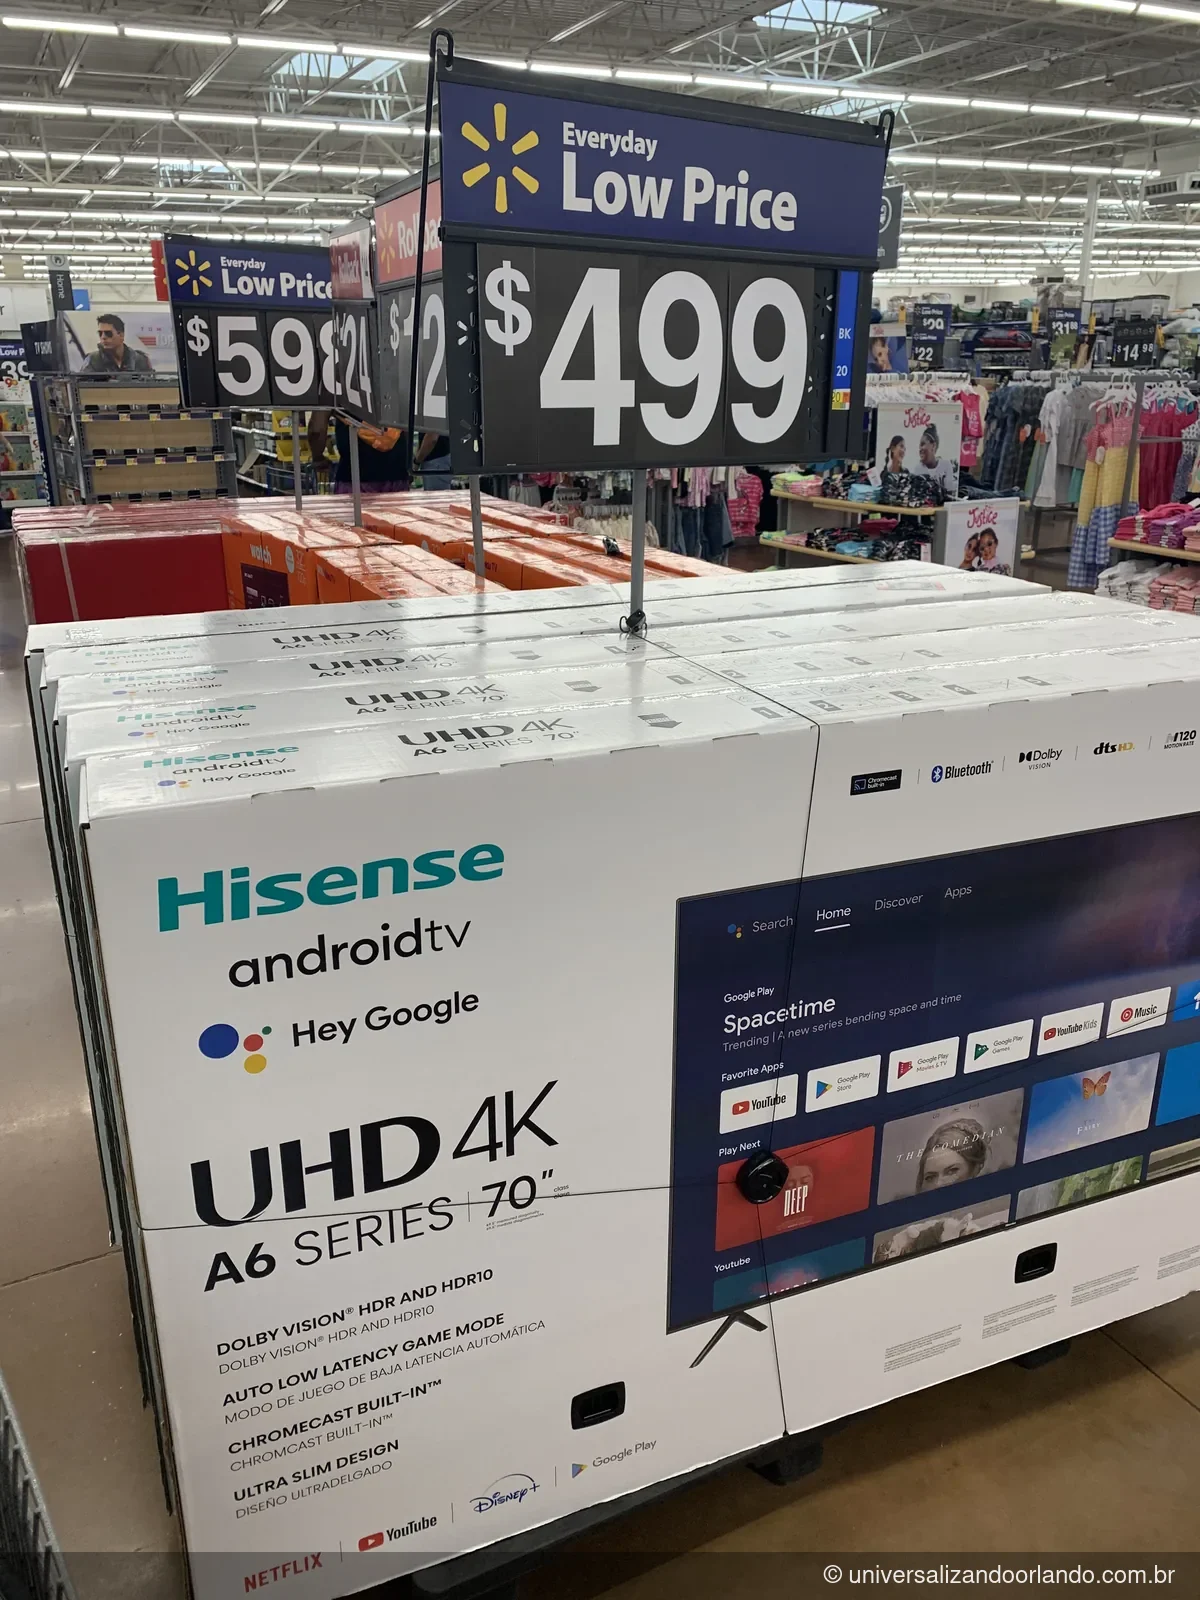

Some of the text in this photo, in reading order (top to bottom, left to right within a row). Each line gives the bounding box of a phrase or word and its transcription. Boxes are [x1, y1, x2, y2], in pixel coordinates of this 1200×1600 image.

[562, 121, 658, 162] Everyday
[563, 151, 797, 231] Low Price
[220, 256, 265, 272] Everyday
[57, 274, 65, 299] Home
[221, 268, 332, 299] Low Price
[838, 328, 852, 340] BK
[484, 260, 807, 446] $499
[836, 365, 848, 377] 20
[904, 408, 931, 428] Justice
[967, 506, 998, 529] Justice
[250, 544, 272, 566] watch
[272, 632, 361, 645] UHD
[309, 657, 405, 670] UHD
[103, 669, 228, 683] Hisense
[345, 689, 450, 706] UHD
[356, 707, 387, 715] A6
[393, 698, 465, 711] SERIES
[117, 704, 256, 723] Hisense
[141, 713, 244, 728] androidtv
[166, 722, 250, 735] Hey Google
[398, 718, 575, 746] UHD 4K
[413, 747, 447, 757] A6
[453, 737, 533, 752] SERIES
[1033, 747, 1062, 763] Dolby
[1093, 742, 1117, 755] dts
[143, 746, 299, 769] Hisense
[173, 758, 286, 775] androidtv
[1028, 761, 1051, 771] VISION
[202, 769, 296, 783] Hey Google
[867, 774, 898, 785] Chromecast
[867, 781, 885, 789] built-in
[157, 843, 504, 933] Hisense
[944, 884, 973, 900] Apps
[874, 893, 923, 911] Discover
[816, 905, 851, 921] Home
[752, 915, 794, 933] Search
[229, 917, 471, 988] androidtv
[723, 985, 775, 1004] Google Play
[291, 990, 479, 1047] Hey Google
[723, 996, 836, 1037] Spacetime
[1134, 1004, 1157, 1018] Music
[723, 1033, 770, 1053] Trending
[788, 1026, 810, 1038] new
[812, 1019, 842, 1034] series
[845, 1009, 886, 1027] bending
[888, 1003, 918, 1018] space
[919, 997, 939, 1009] and
[940, 992, 962, 1005] time
[1056, 1018, 1098, 1037] YouTube Kids
[993, 1034, 1024, 1047] Google Play
[917, 1052, 949, 1066] Google Play
[721, 1060, 784, 1082] Favorite Apps
[836, 1070, 871, 1086] Google Play
[836, 1083, 852, 1093] Store
[751, 1094, 786, 1112] YouTube
[190, 1079, 559, 1227] UHD 4K
[719, 1139, 761, 1159] Play Next
[895, 1147, 924, 1164] THE
[932, 1126, 1005, 1154] COMEDIAN
[783, 1185, 808, 1217] DEEP
[204, 1168, 554, 1292] A6 SERIES 70"
[714, 1255, 751, 1273] Youtube
[216, 1329, 279, 1356] DOLBY
[358, 1295, 395, 1316] HDR
[399, 1284, 437, 1305] AND
[440, 1268, 493, 1293] HDR10
[218, 1352, 267, 1375] DOLBY
[328, 1325, 358, 1343] HDR
[360, 1317, 390, 1335] AND
[393, 1303, 435, 1324] HDR10
[222, 1313, 505, 1407] AUTO LOW LATENCY GAME MODE
[224, 1320, 545, 1425] MODO DE JUEGO DE BAJA LATENCIA AUTOMÁTICA
[229, 1406, 353, 1455] CHROMECAST
[230, 1435, 323, 1472] CHROMCAST
[592, 1438, 658, 1469] Google Play
[234, 1439, 399, 1502] ULTRA SLIM DESIGN
[235, 1460, 393, 1519] DISEÑO ULTRADELGADO
[386, 1515, 437, 1543] YouTube
[244, 1552, 323, 1592] NETFLIX
